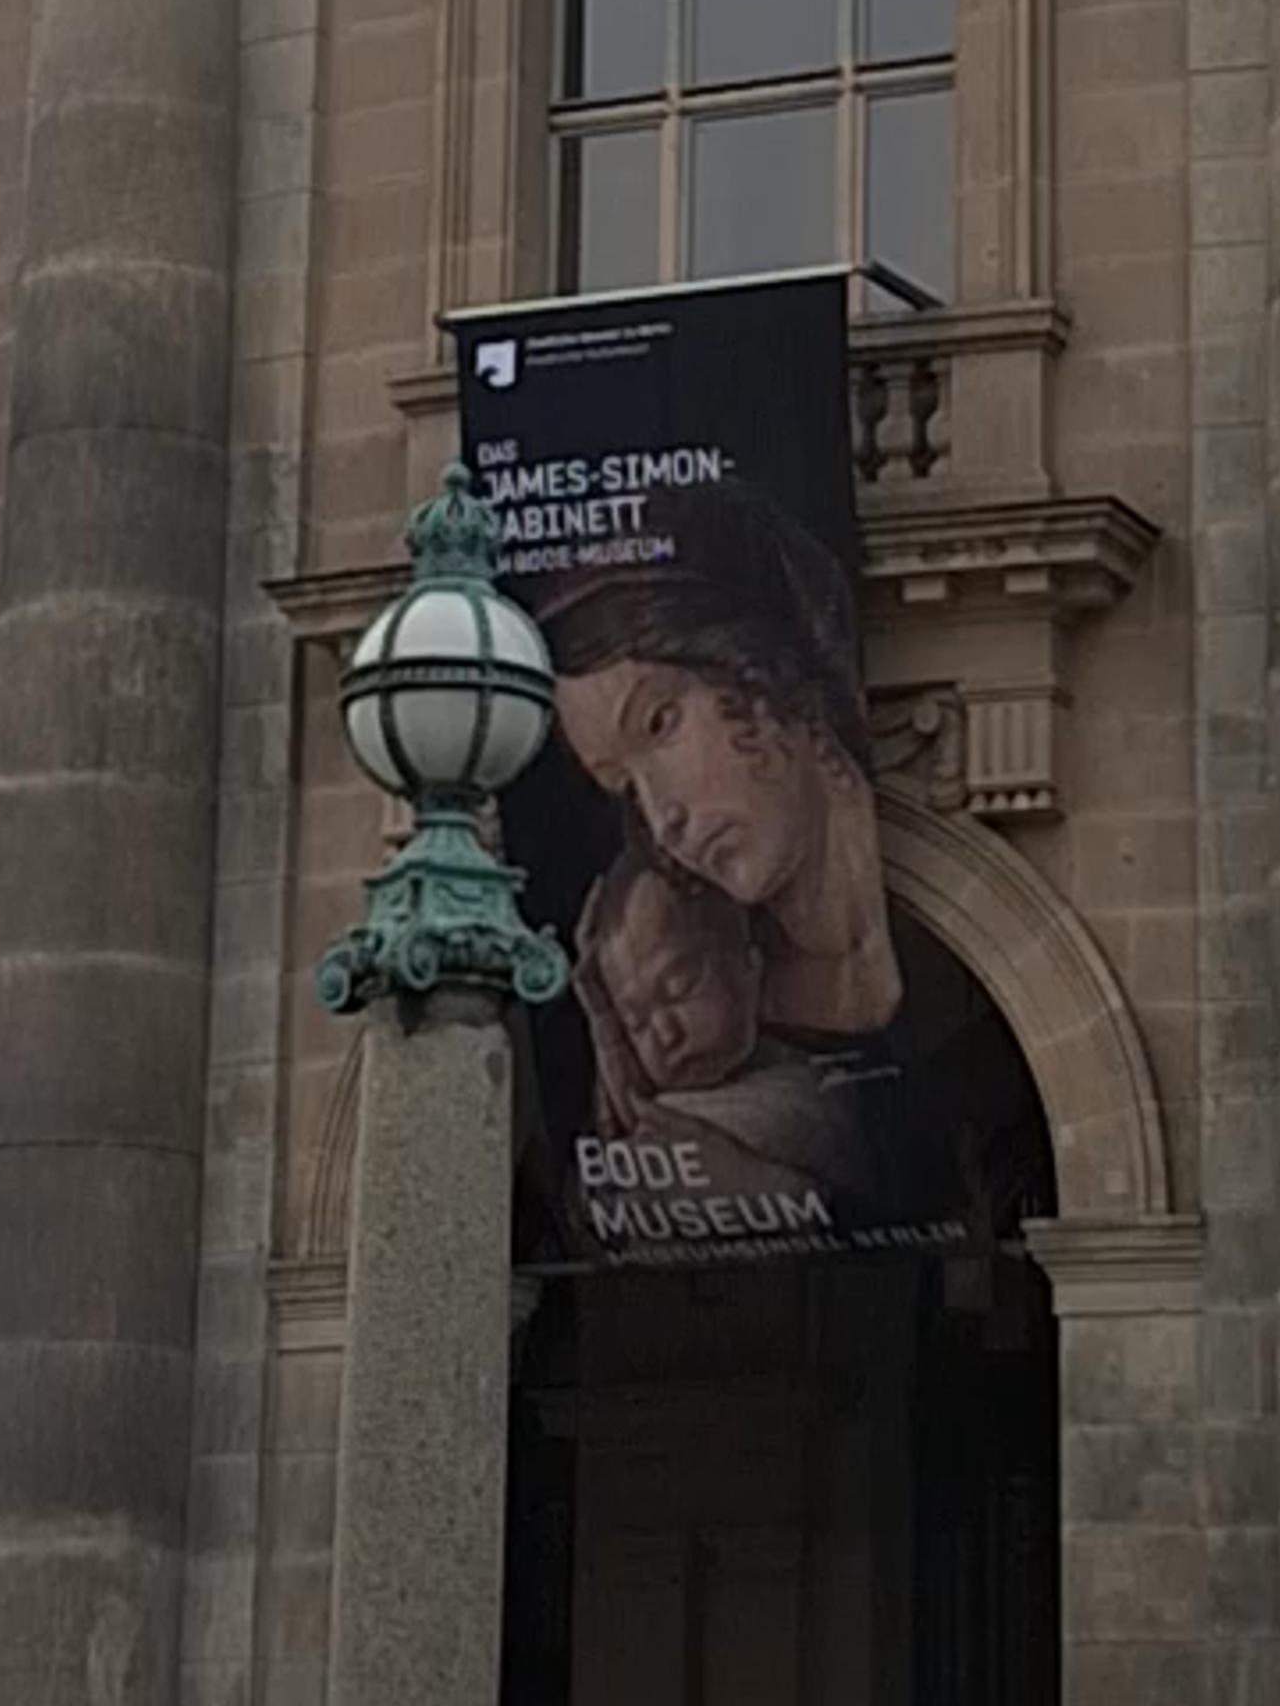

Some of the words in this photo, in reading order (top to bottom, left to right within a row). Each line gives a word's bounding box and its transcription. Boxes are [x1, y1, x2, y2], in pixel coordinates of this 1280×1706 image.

[477, 440, 518, 465] DAS
[481, 448, 734, 505] JAMES-SIMON-
[487, 495, 647, 542] ABINETT
[576, 1137, 711, 1188] BODE
[588, 1191, 831, 1240] MUSEUM
[853, 1222, 968, 1248] BERLIN
